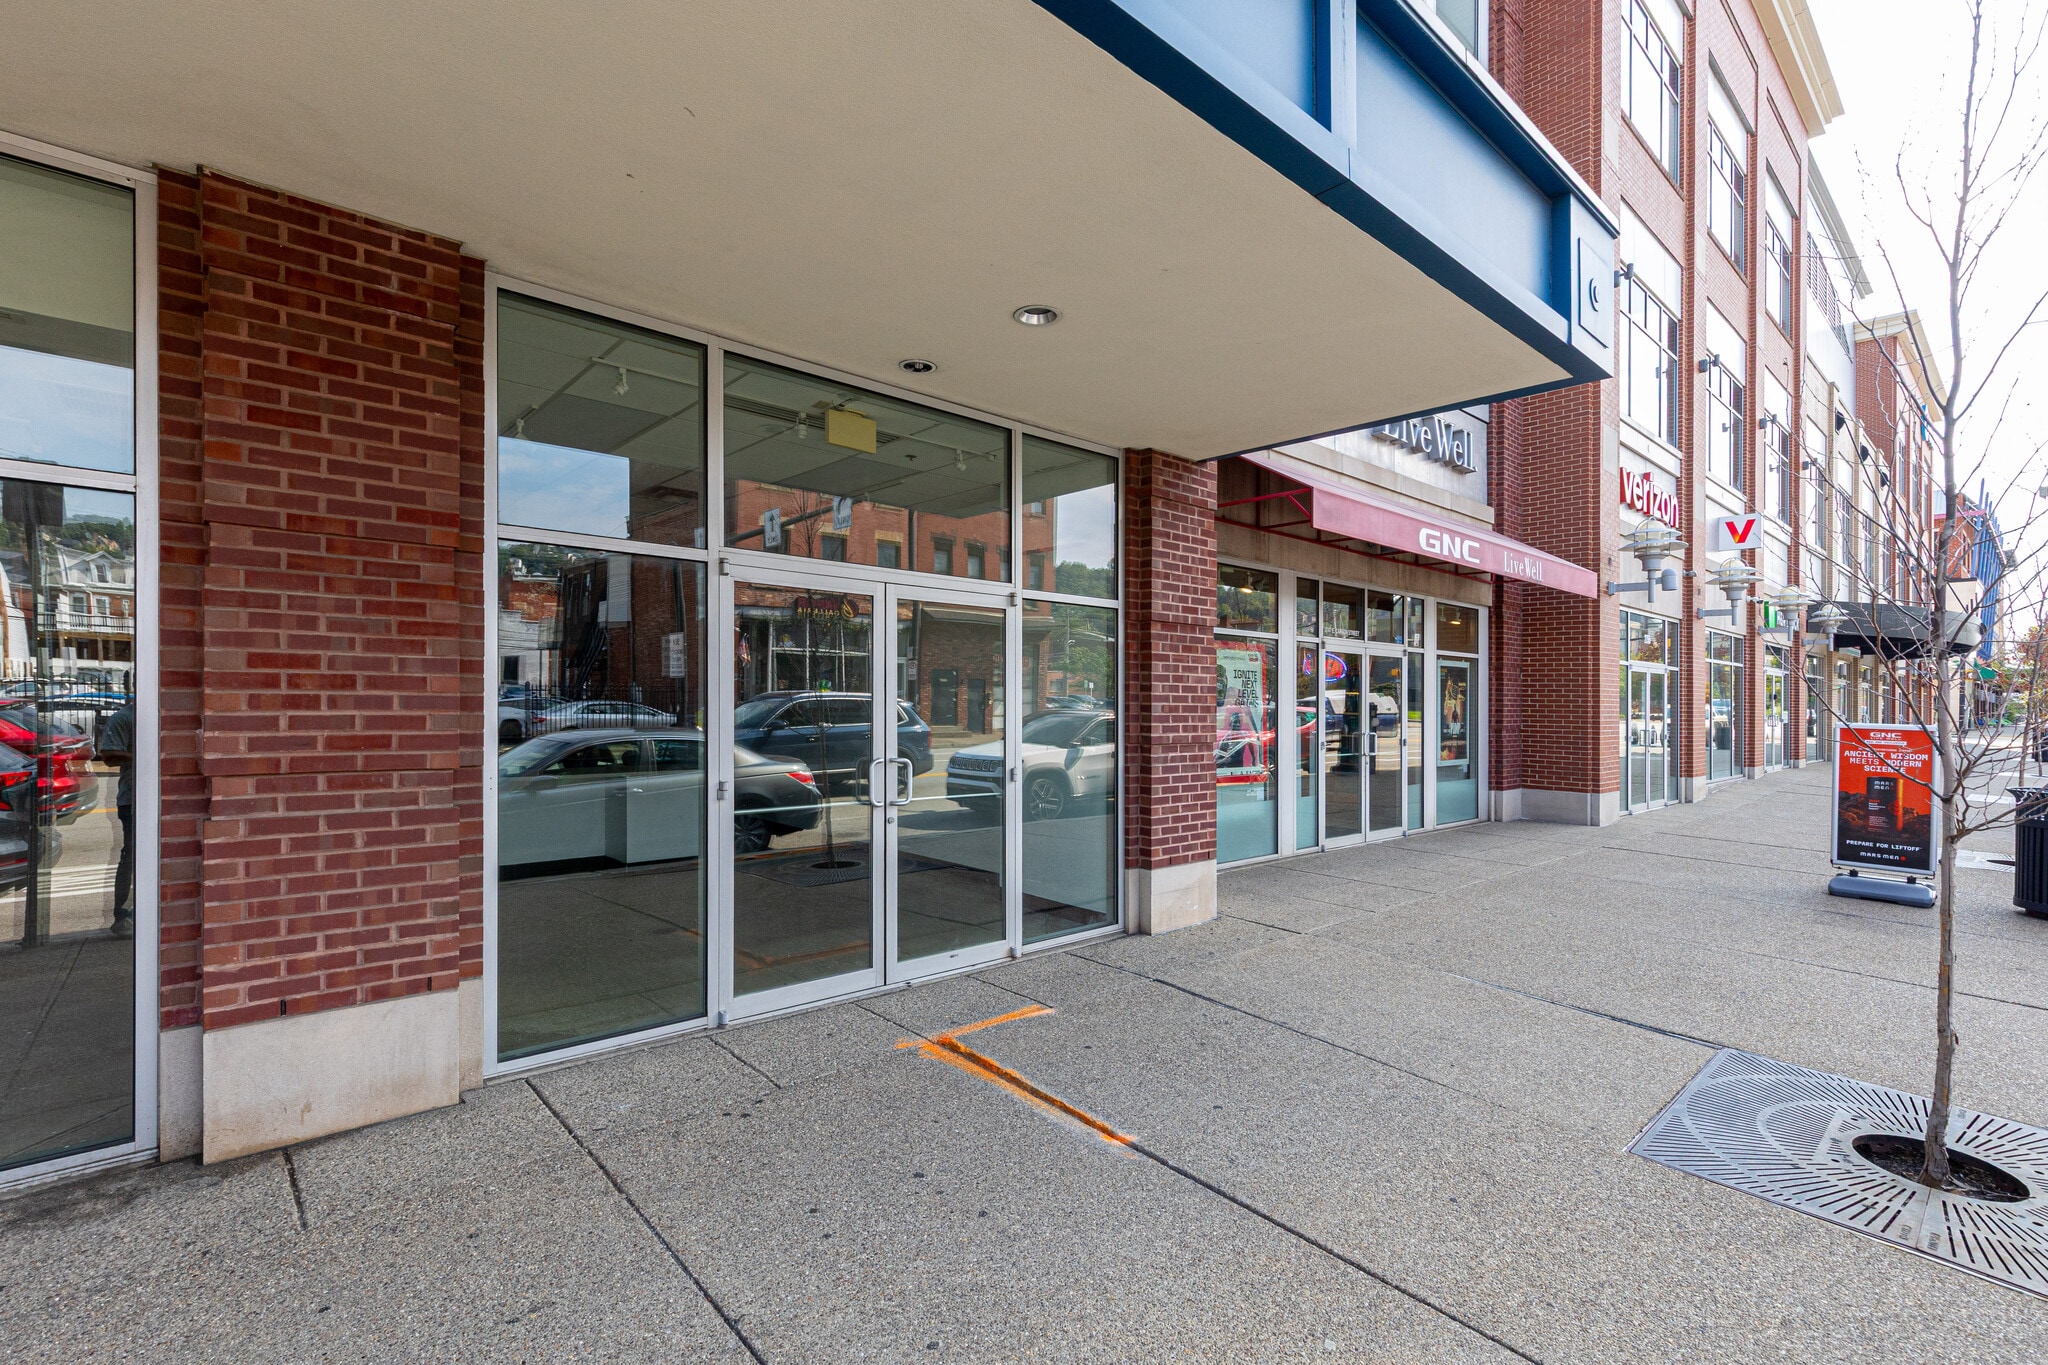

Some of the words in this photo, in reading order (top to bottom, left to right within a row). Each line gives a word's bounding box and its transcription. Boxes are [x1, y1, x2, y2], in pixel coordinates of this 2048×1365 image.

[1620, 467, 1680, 528] verizon
[1419, 527, 1480, 564] GNC
[1233, 669, 1257, 680] IGNITE
[1241, 680, 1257, 689] NEXT
[1238, 689, 1259, 699] LEVEL
[1870, 731, 1902, 739] GNC
[1849, 757, 1880, 765] MEETS
[1890, 752, 1929, 761] WISDOM
[1846, 839, 1874, 848] PREPARE
